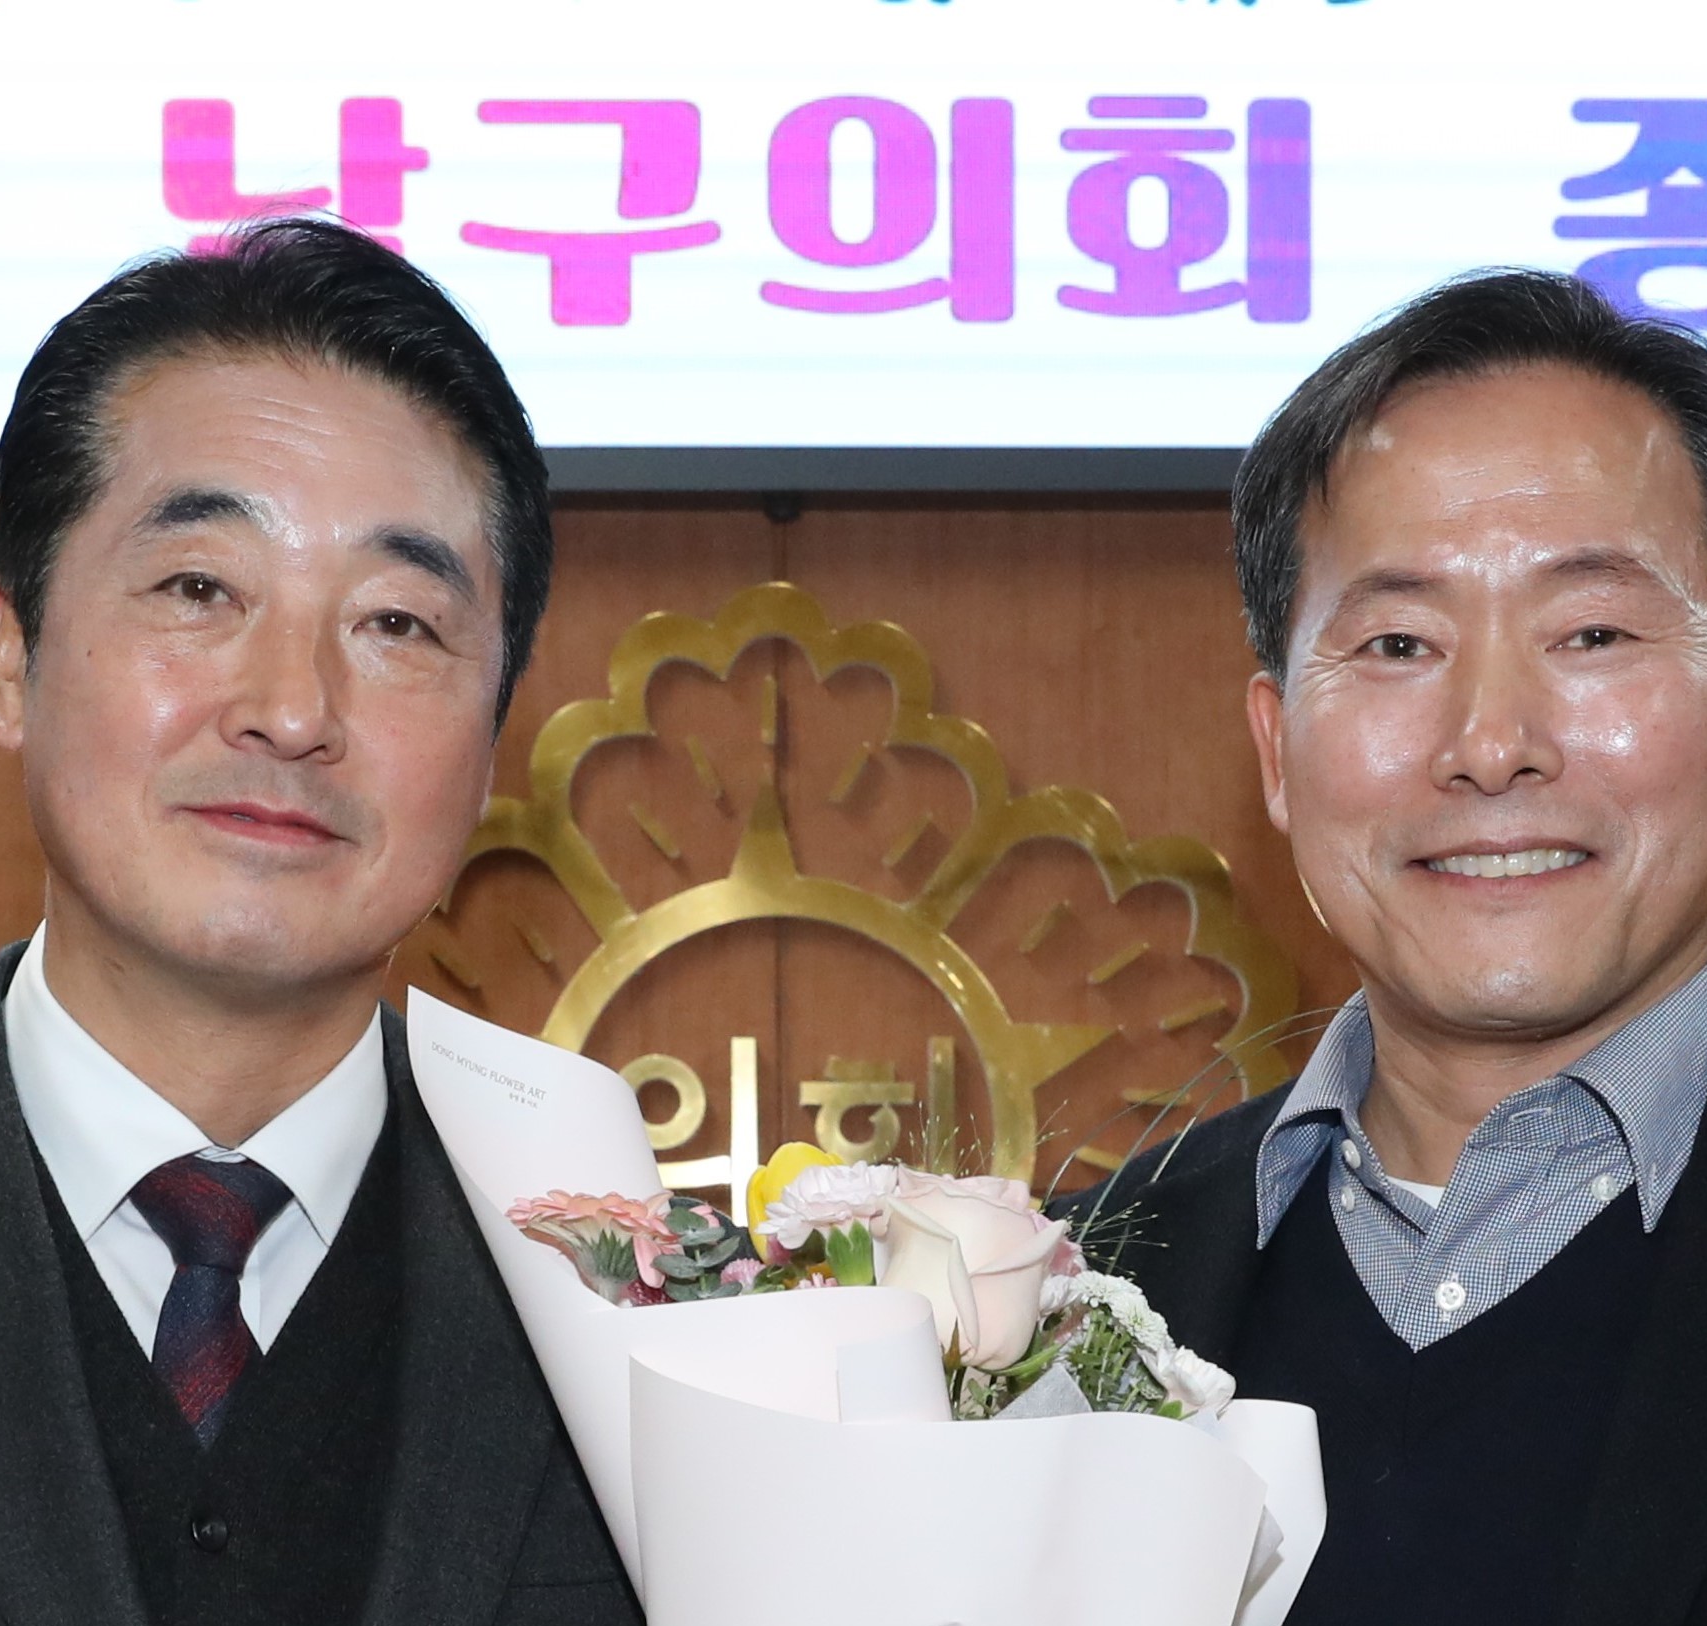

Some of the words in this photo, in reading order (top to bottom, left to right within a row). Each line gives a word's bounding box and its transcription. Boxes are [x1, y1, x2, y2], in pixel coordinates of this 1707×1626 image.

[162, 97, 1310, 327] 남구의회
[431, 1041, 454, 1061] DONG
[457, 1054, 487, 1077] MYUNG
[489, 1070, 526, 1093] FLOWER
[527, 1086, 547, 1101] ART
